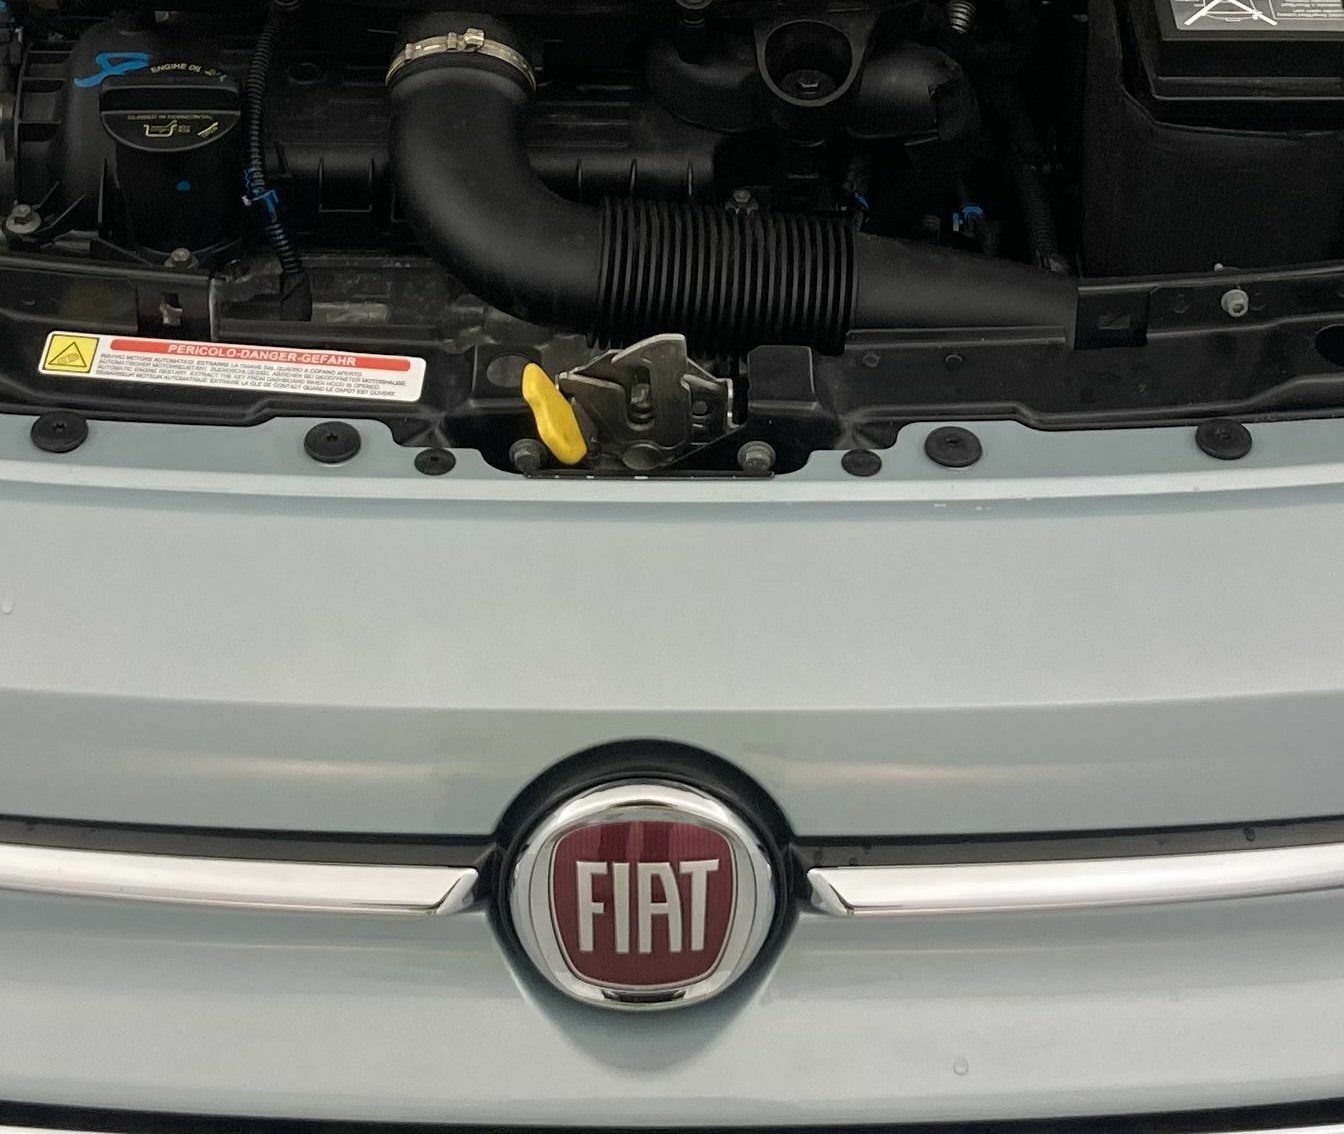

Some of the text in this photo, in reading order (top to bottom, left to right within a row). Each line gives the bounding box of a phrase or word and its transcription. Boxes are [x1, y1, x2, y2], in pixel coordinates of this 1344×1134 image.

[150, 63, 202, 74] ENGINE OIL
[167, 344, 356, 366] PERICOLO-DANGER-GEFAHR
[575, 858, 720, 954] FIAT
